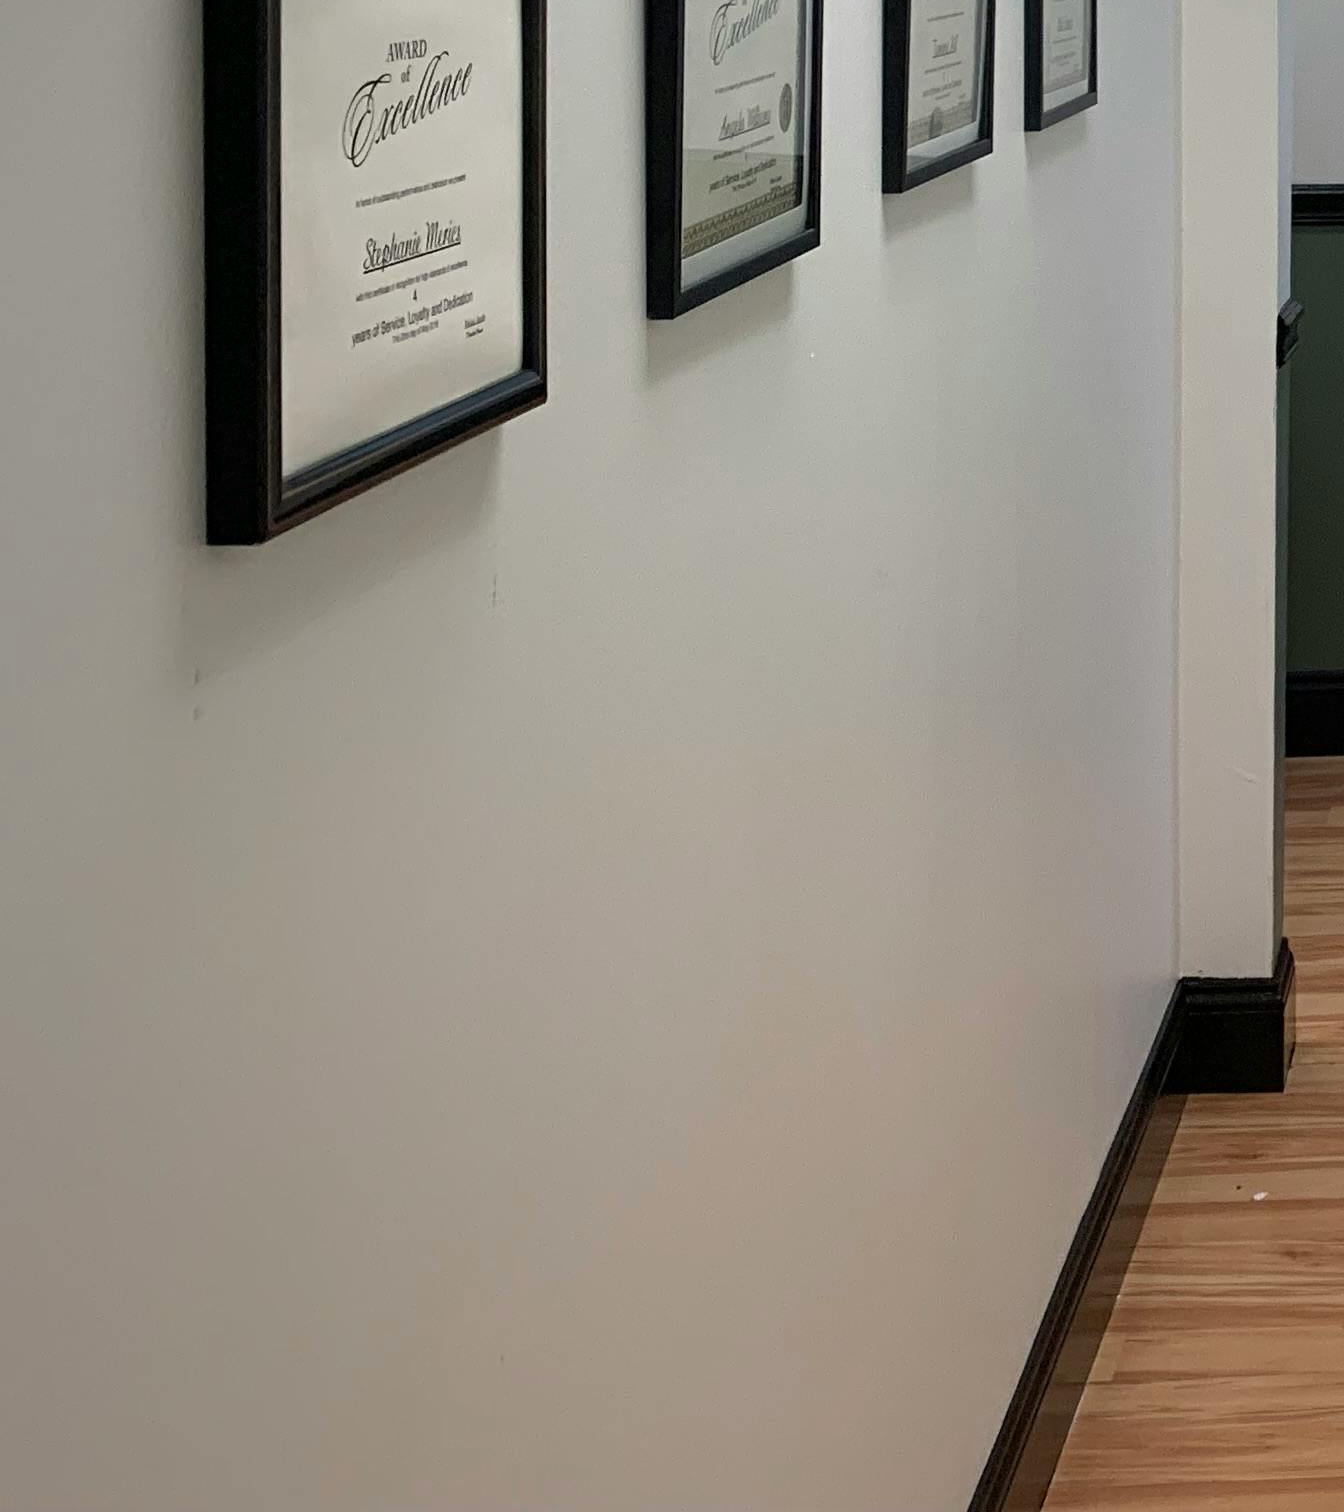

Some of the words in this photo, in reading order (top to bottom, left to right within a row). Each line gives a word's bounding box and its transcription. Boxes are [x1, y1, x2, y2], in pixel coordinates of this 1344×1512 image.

[387, 39, 427, 62] AWARD
[401, 64, 412, 83] of
[342, 51, 473, 167] Excellence
[363, 231, 421, 272] Stephanie
[352, 328, 371, 348] years
[372, 323, 380, 338] of
[431, 301, 442, 317] and
[443, 292, 474, 312] Dedication
